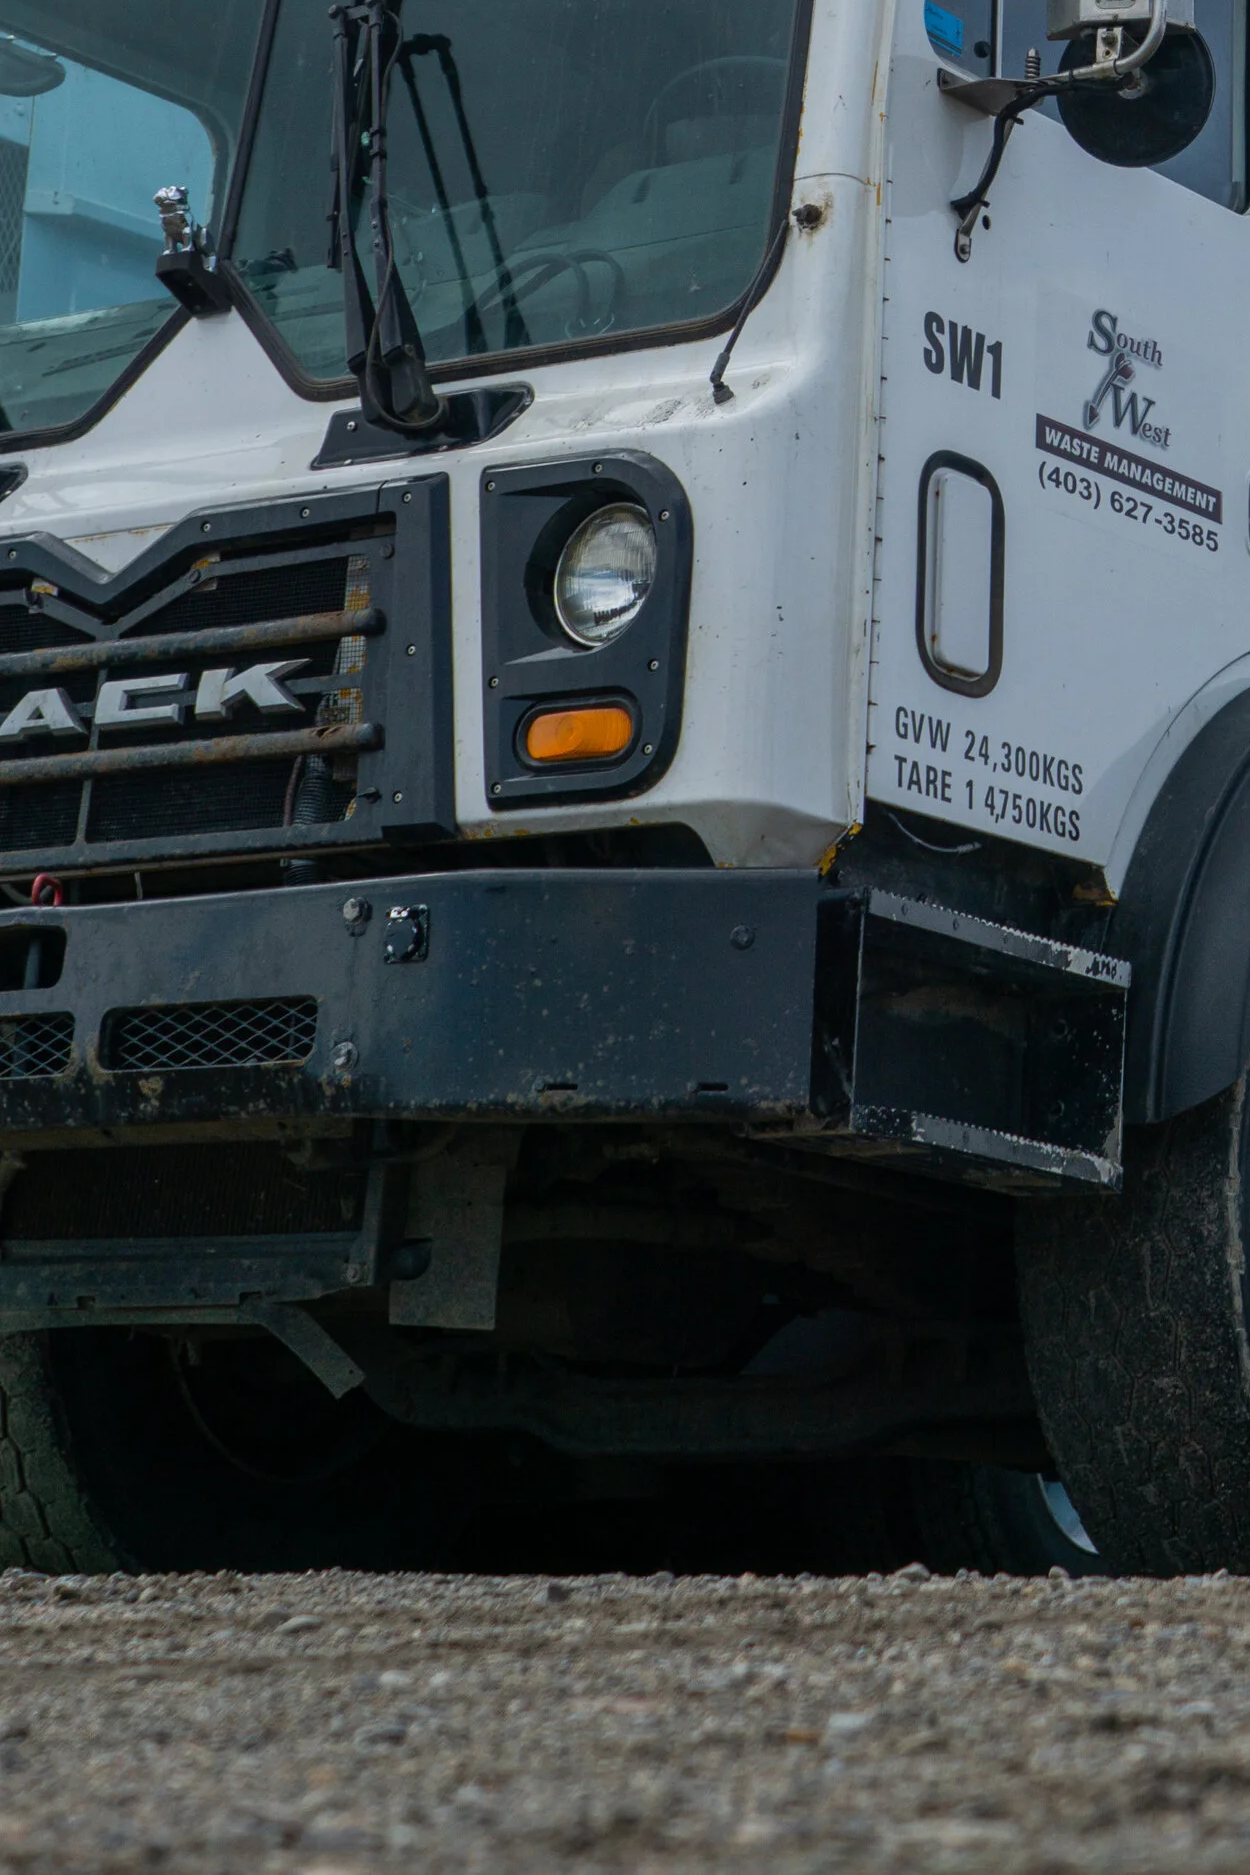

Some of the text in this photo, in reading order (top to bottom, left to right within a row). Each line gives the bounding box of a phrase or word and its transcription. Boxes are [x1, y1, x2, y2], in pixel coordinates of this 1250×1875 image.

[923, 311, 1003, 400] SW1
[1087, 309, 1164, 368] South
[1110, 381, 1172, 447] West
[1038, 460, 1219, 553] (403) 627-3585
[1044, 426, 1217, 513] WASTE MANAGEMENT
[894, 754, 953, 804] TARE
[895, 706, 1083, 795] GVW 24,300KGS
